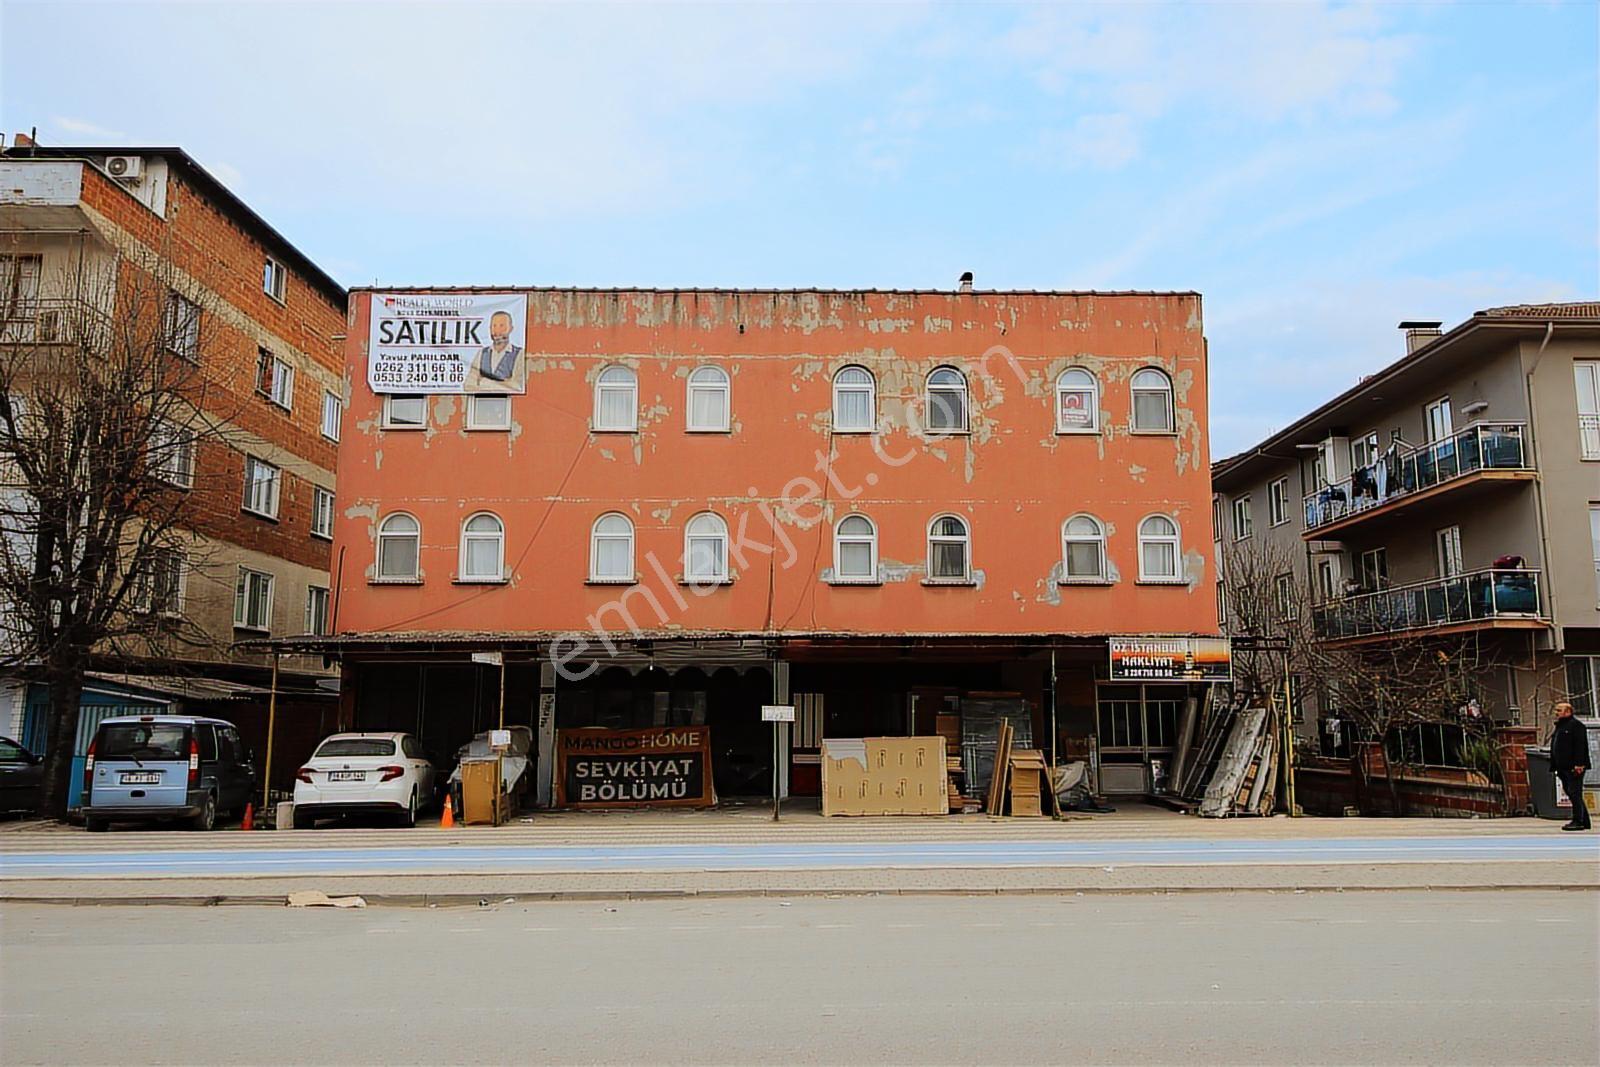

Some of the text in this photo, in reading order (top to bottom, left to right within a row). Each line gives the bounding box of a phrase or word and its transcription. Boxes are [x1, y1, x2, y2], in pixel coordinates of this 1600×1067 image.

[379, 320, 482, 344] SATILIK
[373, 373, 402, 383] 0533
[406, 373, 428, 383] 240
[431, 373, 445, 383] 41
[375, 362, 464, 373] 0262 311 66 36
[575, 756, 693, 778] SEVKİYAT
[581, 777, 687, 801] BÖLÜMÜ
